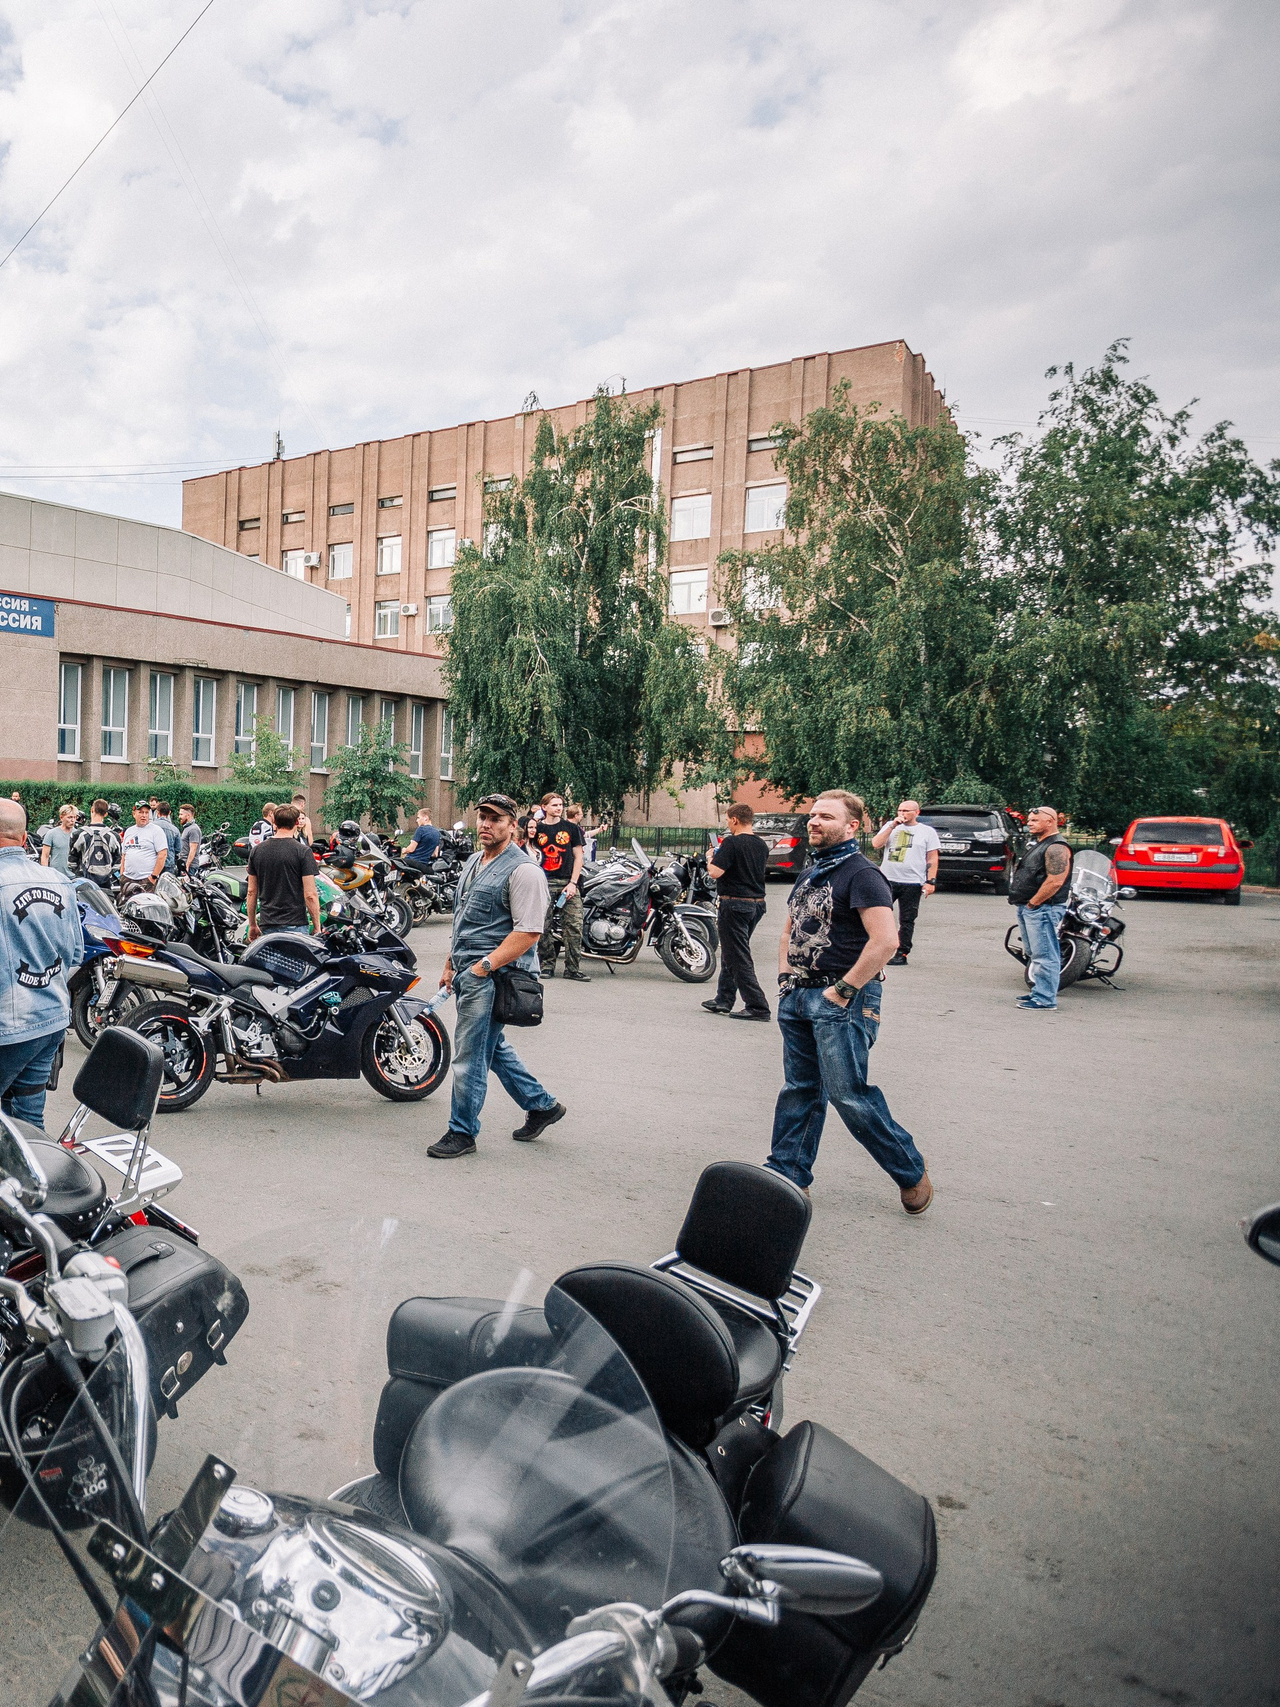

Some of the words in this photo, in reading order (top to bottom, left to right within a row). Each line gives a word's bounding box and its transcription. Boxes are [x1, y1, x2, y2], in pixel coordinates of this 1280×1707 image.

[15, 892, 32, 909] LIVE
[32, 890, 41, 899] TO
[42, 891, 60, 905] RIDE
[19, 972, 39, 986] RIDE
[83, 1478, 107, 1497] DOT
